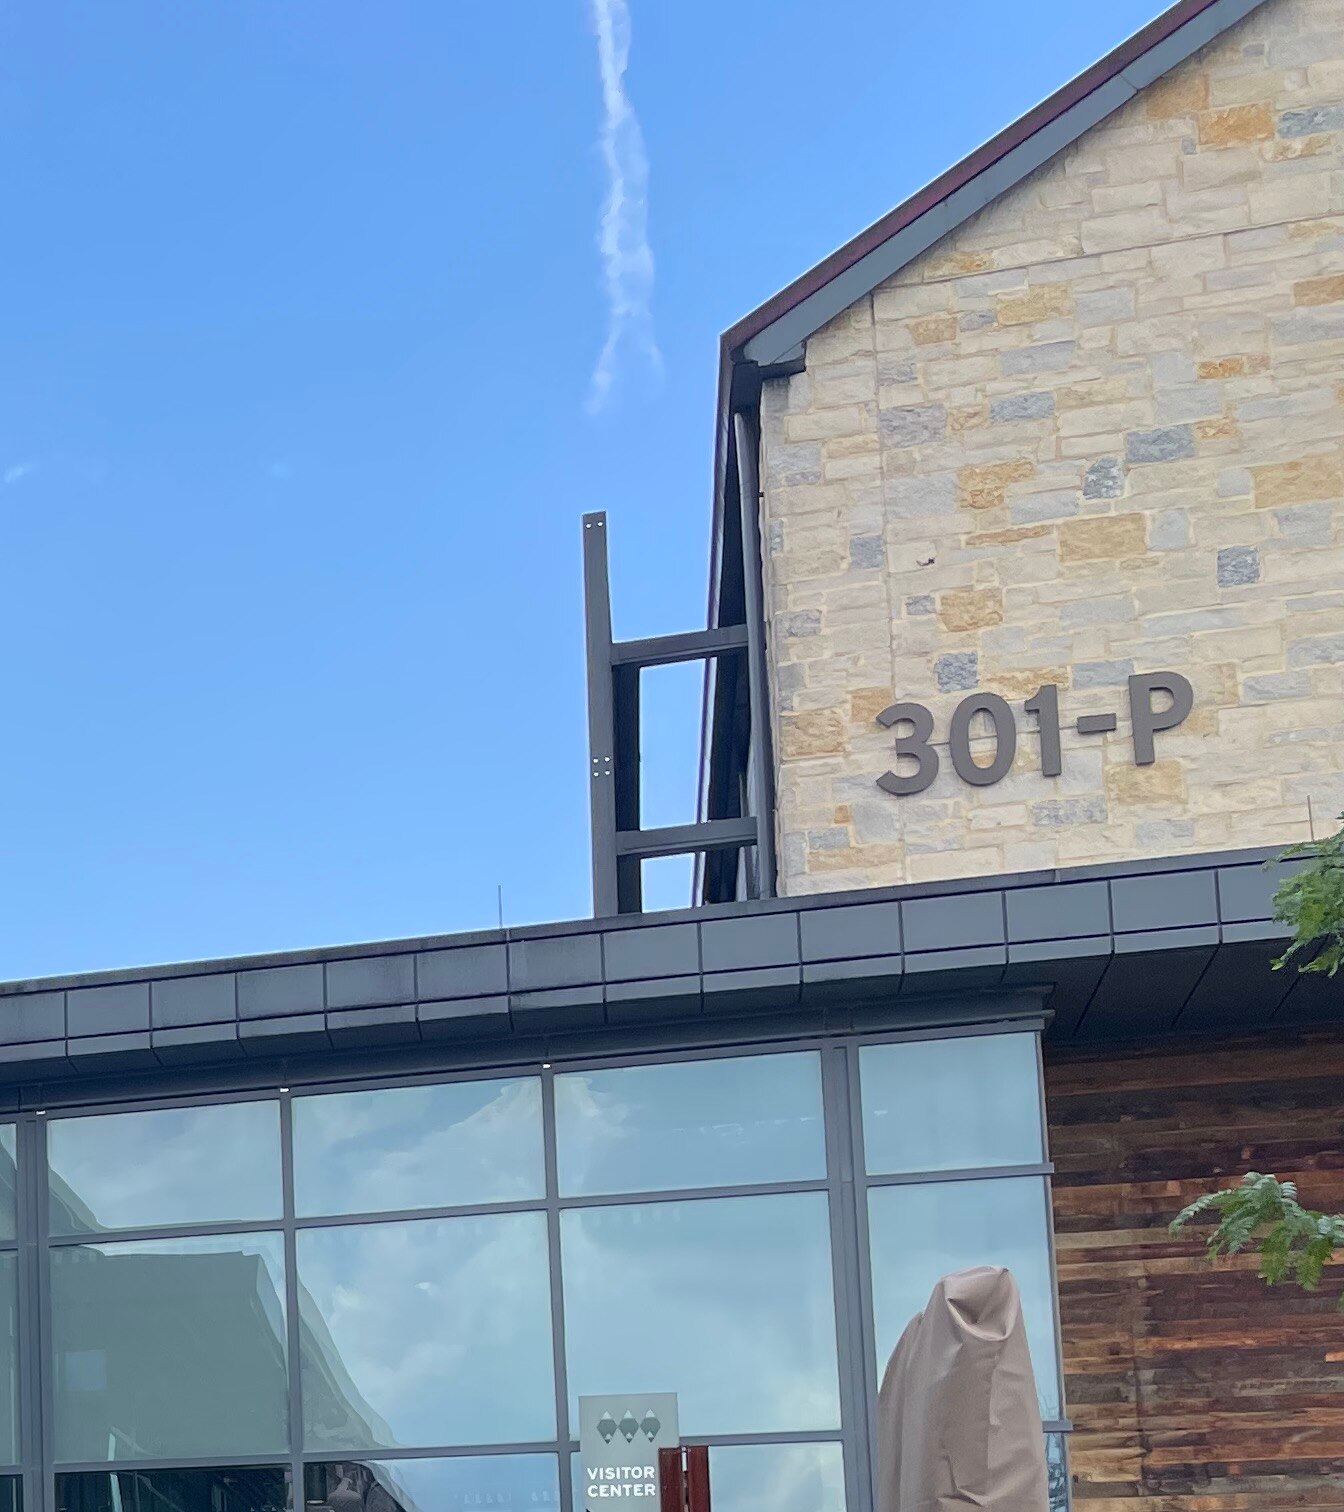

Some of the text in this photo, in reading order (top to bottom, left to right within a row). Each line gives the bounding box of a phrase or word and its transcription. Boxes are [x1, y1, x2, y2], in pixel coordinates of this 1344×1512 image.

[875, 671, 1194, 796] 301-P
[586, 1466, 655, 1480] VISITOR
[587, 1483, 656, 1498] CENTER
